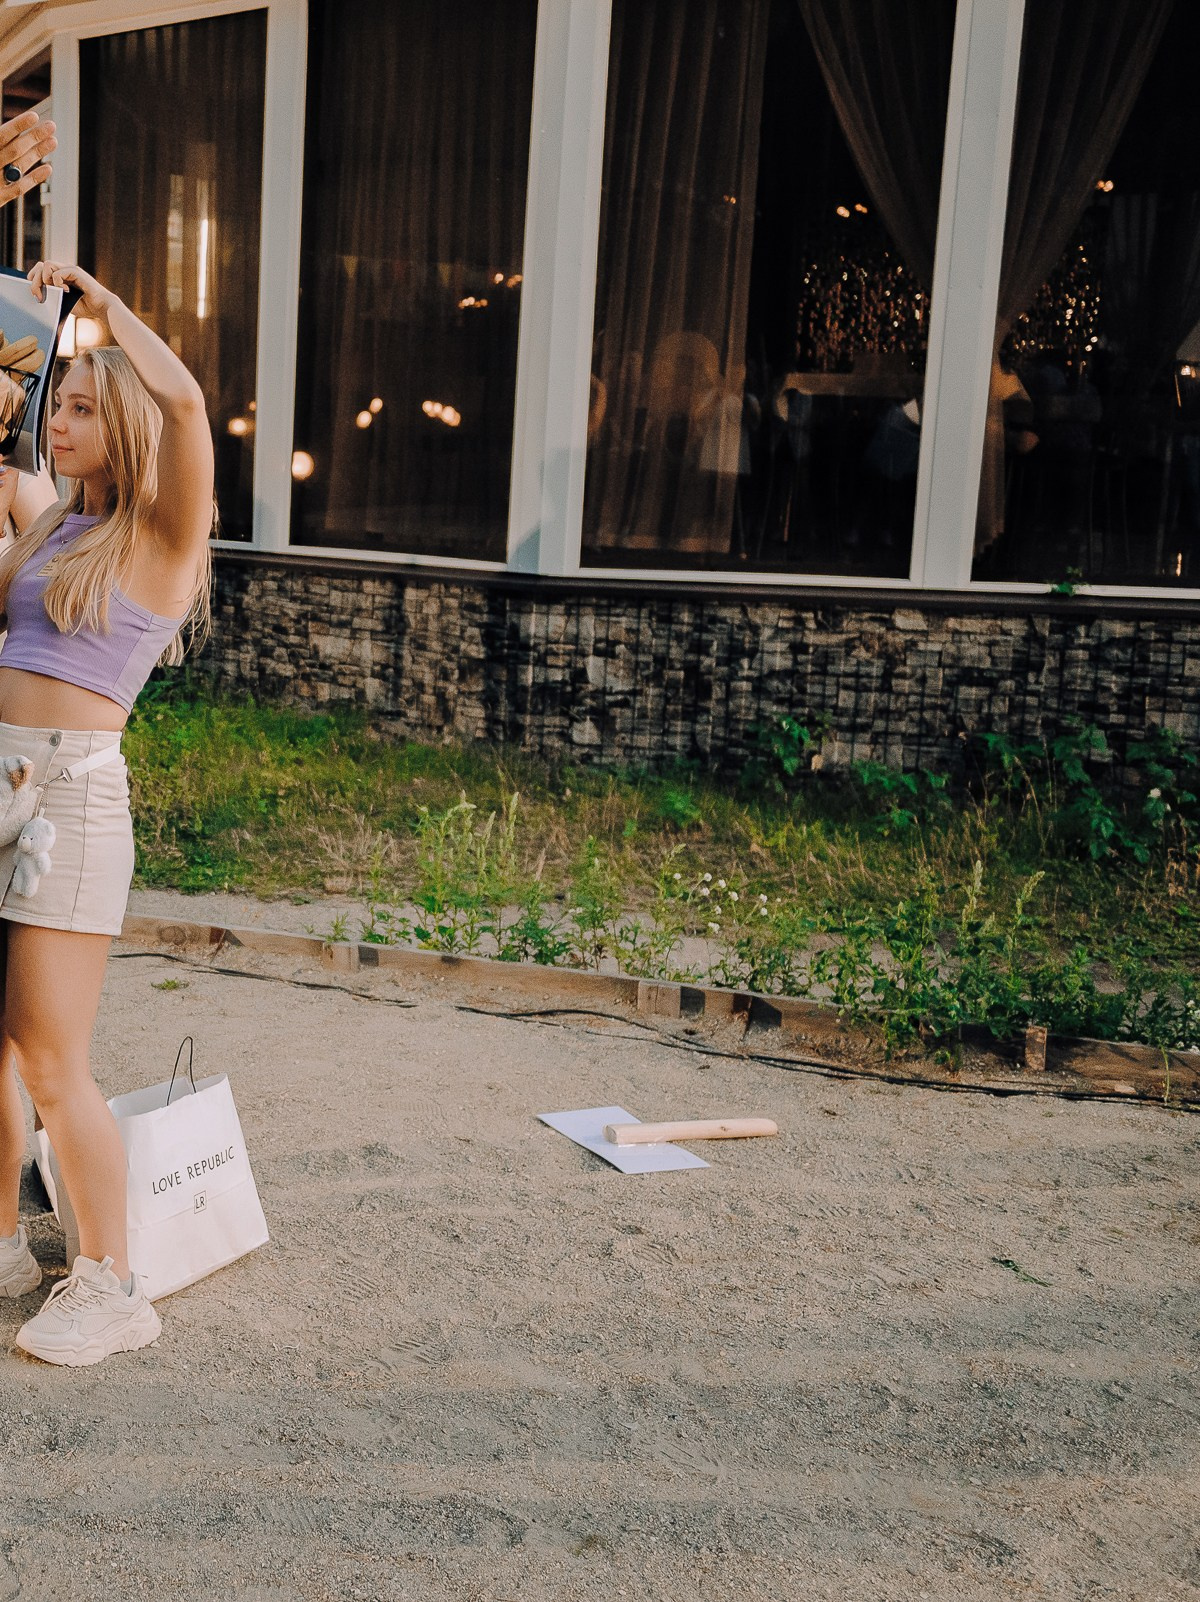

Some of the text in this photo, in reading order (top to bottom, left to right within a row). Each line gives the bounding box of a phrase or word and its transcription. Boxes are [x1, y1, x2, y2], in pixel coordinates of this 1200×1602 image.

[152, 1145, 235, 1194] LOVE REPUBLIC
[195, 1196, 205, 1209] LR
